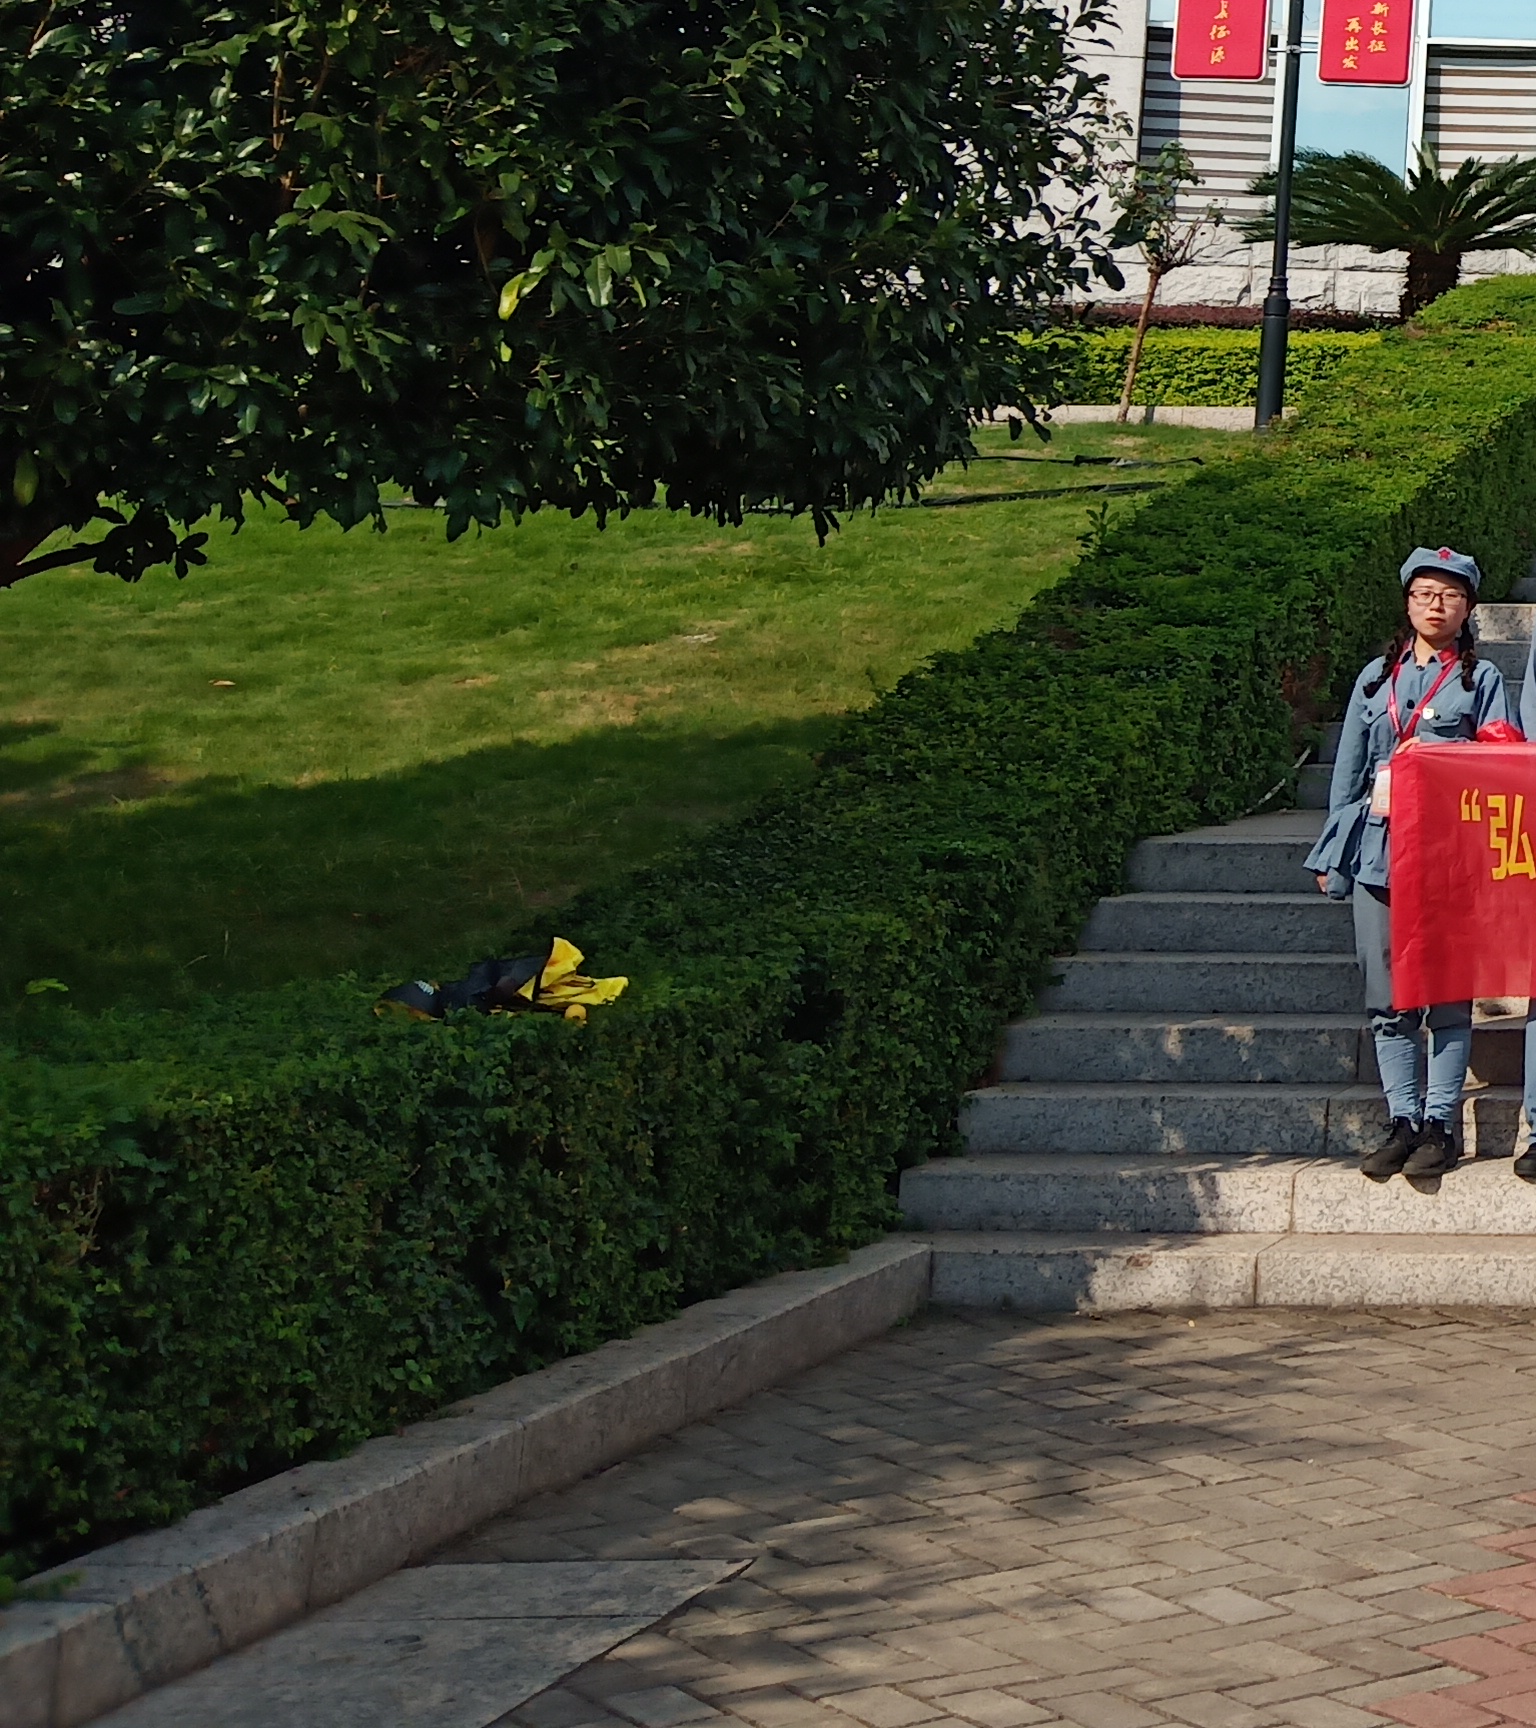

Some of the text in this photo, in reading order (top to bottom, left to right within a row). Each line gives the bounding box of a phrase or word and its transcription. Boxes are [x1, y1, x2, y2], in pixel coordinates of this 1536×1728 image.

[1342, 16, 1363, 70] 再出发
[1366, 1, 1390, 53] 新长征
